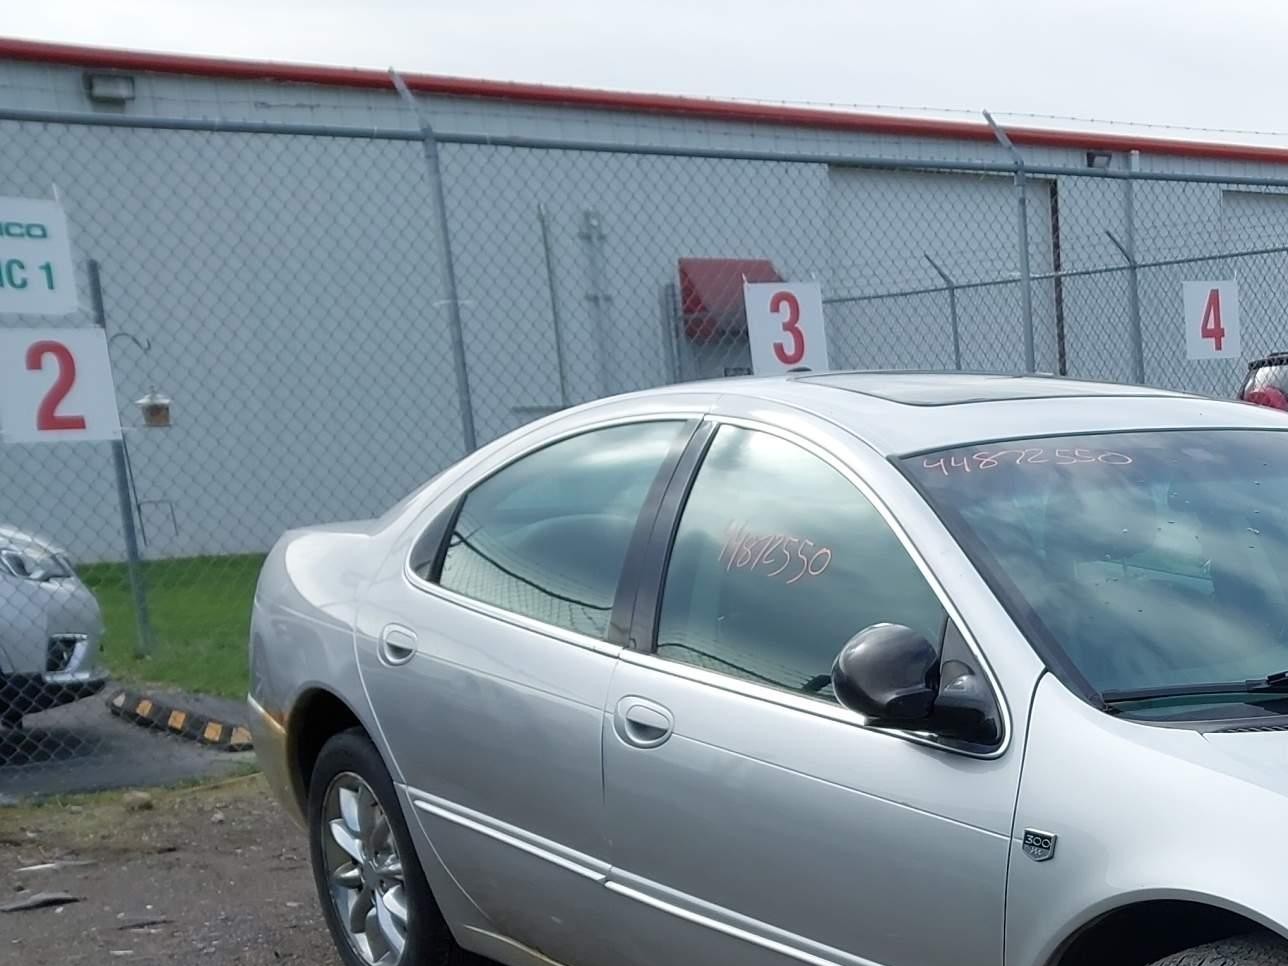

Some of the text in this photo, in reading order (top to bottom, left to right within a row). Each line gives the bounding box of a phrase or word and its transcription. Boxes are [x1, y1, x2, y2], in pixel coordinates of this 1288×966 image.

[38, 261, 54, 290] 1
[770, 291, 805, 365] 3
[1201, 288, 1225, 351] 4
[25, 340, 86, 430] 2
[923, 448, 1133, 475] 44872550
[1025, 834, 1051, 848] 300
